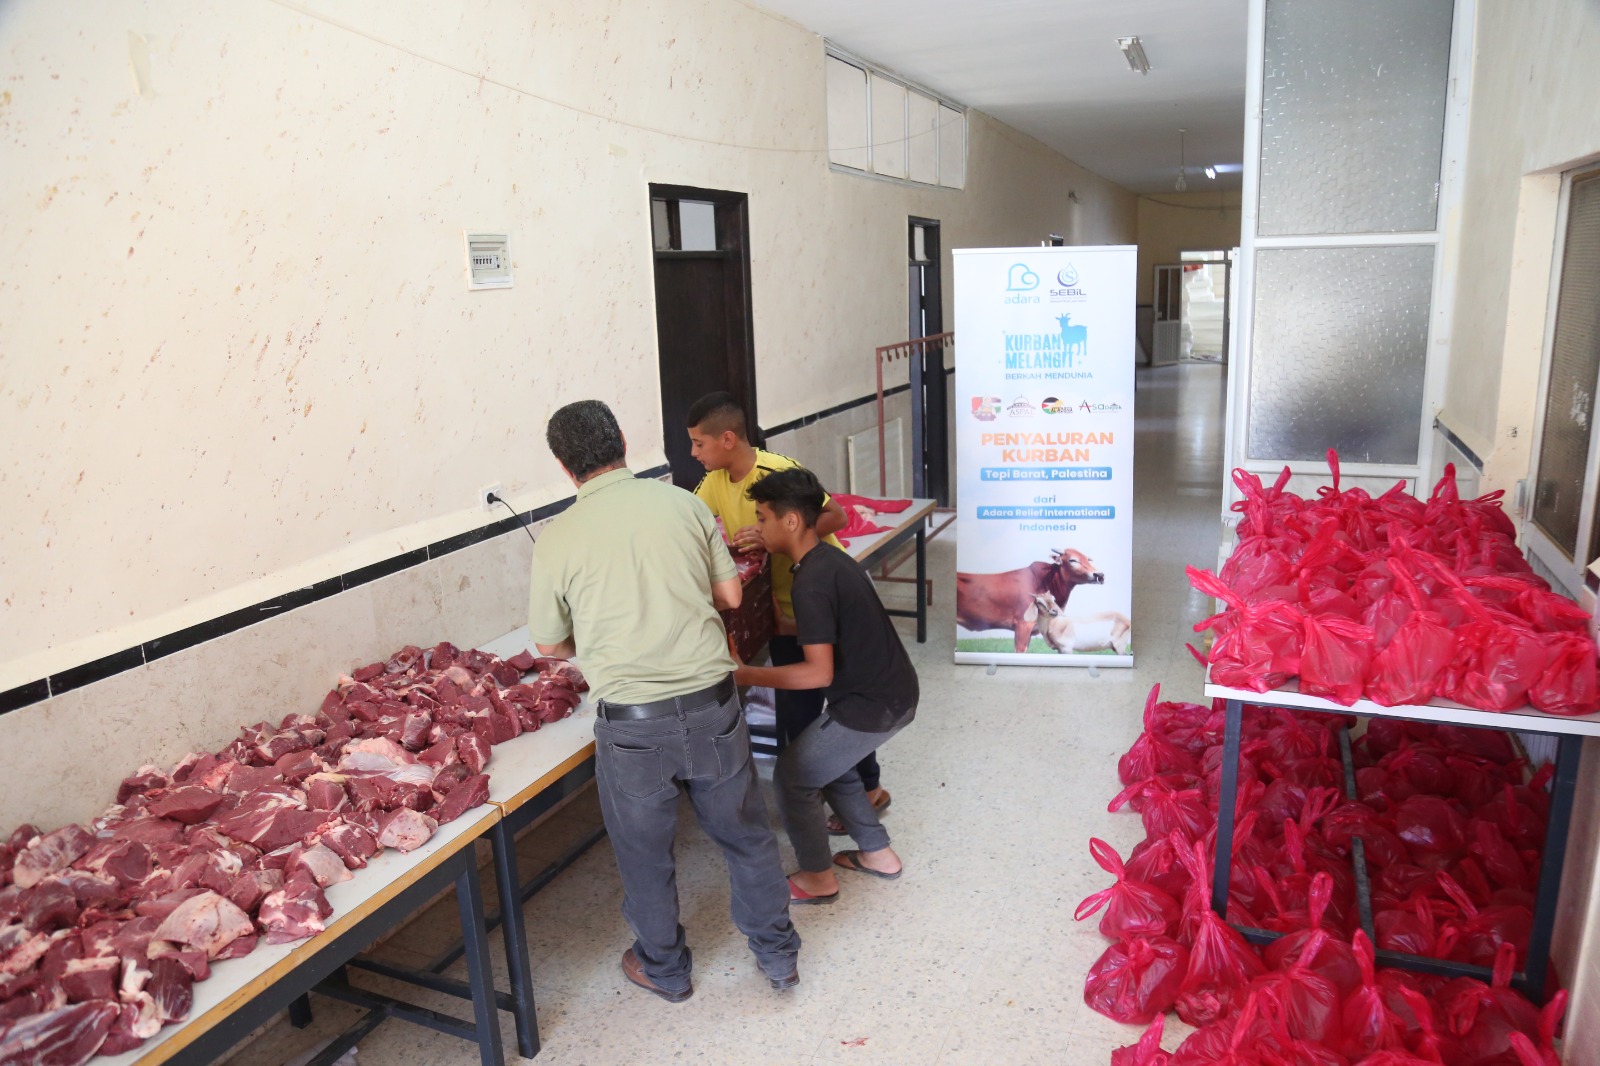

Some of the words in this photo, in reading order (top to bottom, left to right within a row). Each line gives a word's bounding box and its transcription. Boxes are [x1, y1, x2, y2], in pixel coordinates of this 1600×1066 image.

[1004, 293, 1040, 304] adara
[1005, 334, 1061, 352] KURBAN
[1005, 351, 1074, 369] MELANGIT
[1045, 372, 1093, 380] MENDUNIA
[981, 431, 1114, 446] PENYALURAN
[1002, 448, 1090, 463] KURBAN
[985, 469, 1010, 481] Tepi
[1012, 469, 1049, 480] Barat,
[1051, 469, 1108, 479] Palestina
[1033, 494, 1056, 504] dari
[982, 509, 1014, 517] Adara
[1015, 508, 1044, 517] Relief
[1045, 508, 1110, 517] International
[1019, 522, 1077, 532] Indonesia
